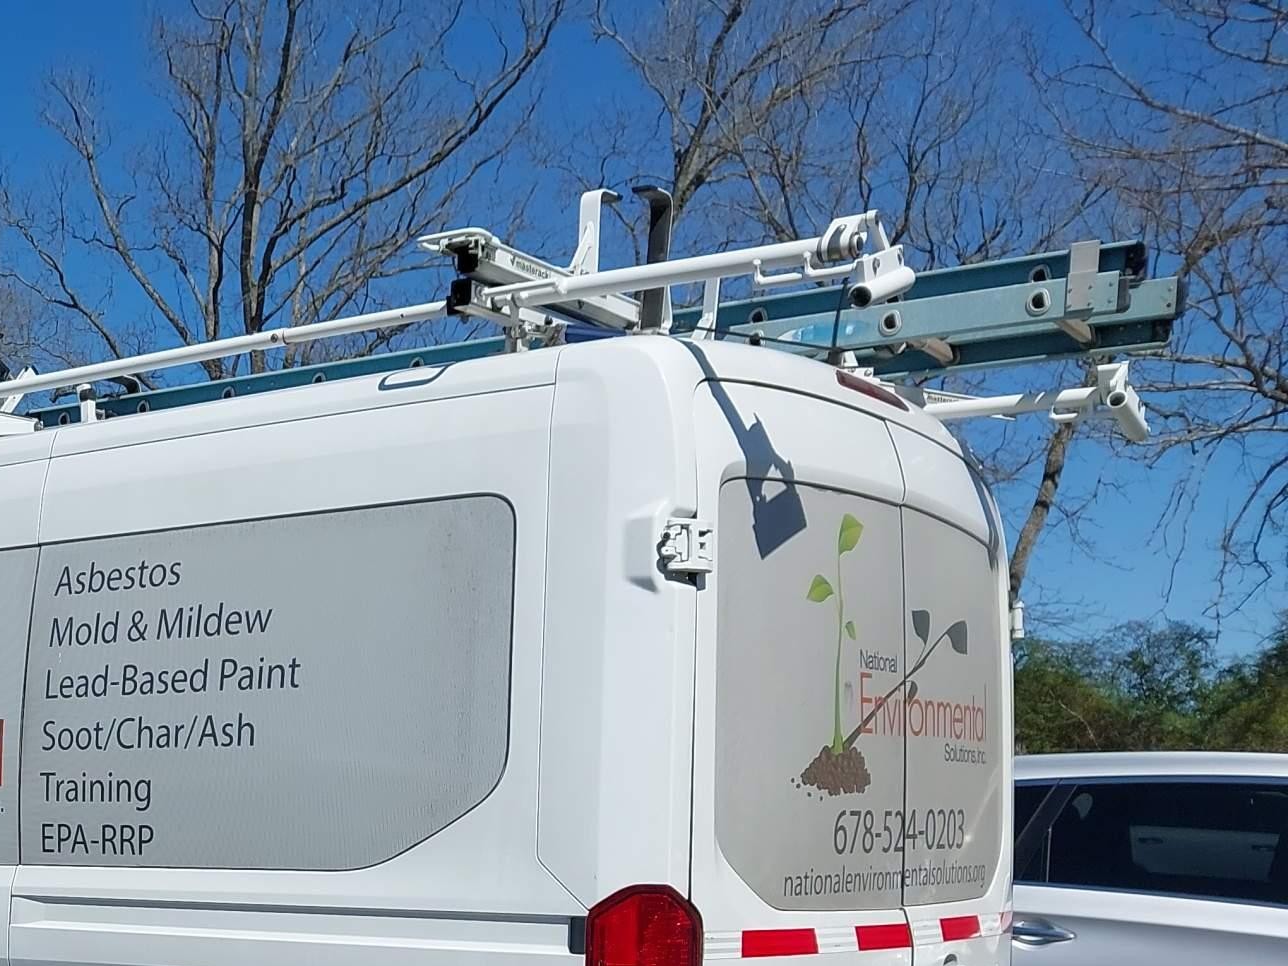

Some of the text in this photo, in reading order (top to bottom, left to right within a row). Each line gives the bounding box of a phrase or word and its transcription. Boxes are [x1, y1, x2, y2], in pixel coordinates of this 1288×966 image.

[54, 560, 181, 596] Asbestos
[49, 602, 273, 648] Mold & Mildew
[45, 657, 301, 699] Lead-Based Paint
[860, 650, 898, 673] National
[860, 672, 987, 742] Environmental
[42, 713, 255, 751] Soot/Char/Ash
[40, 772, 151, 811] Training
[41, 823, 155, 856] EPA-RRP
[833, 809, 965, 855] 678-524-0203
[784, 860, 986, 897] nationalenvironmentalsolutions.org
